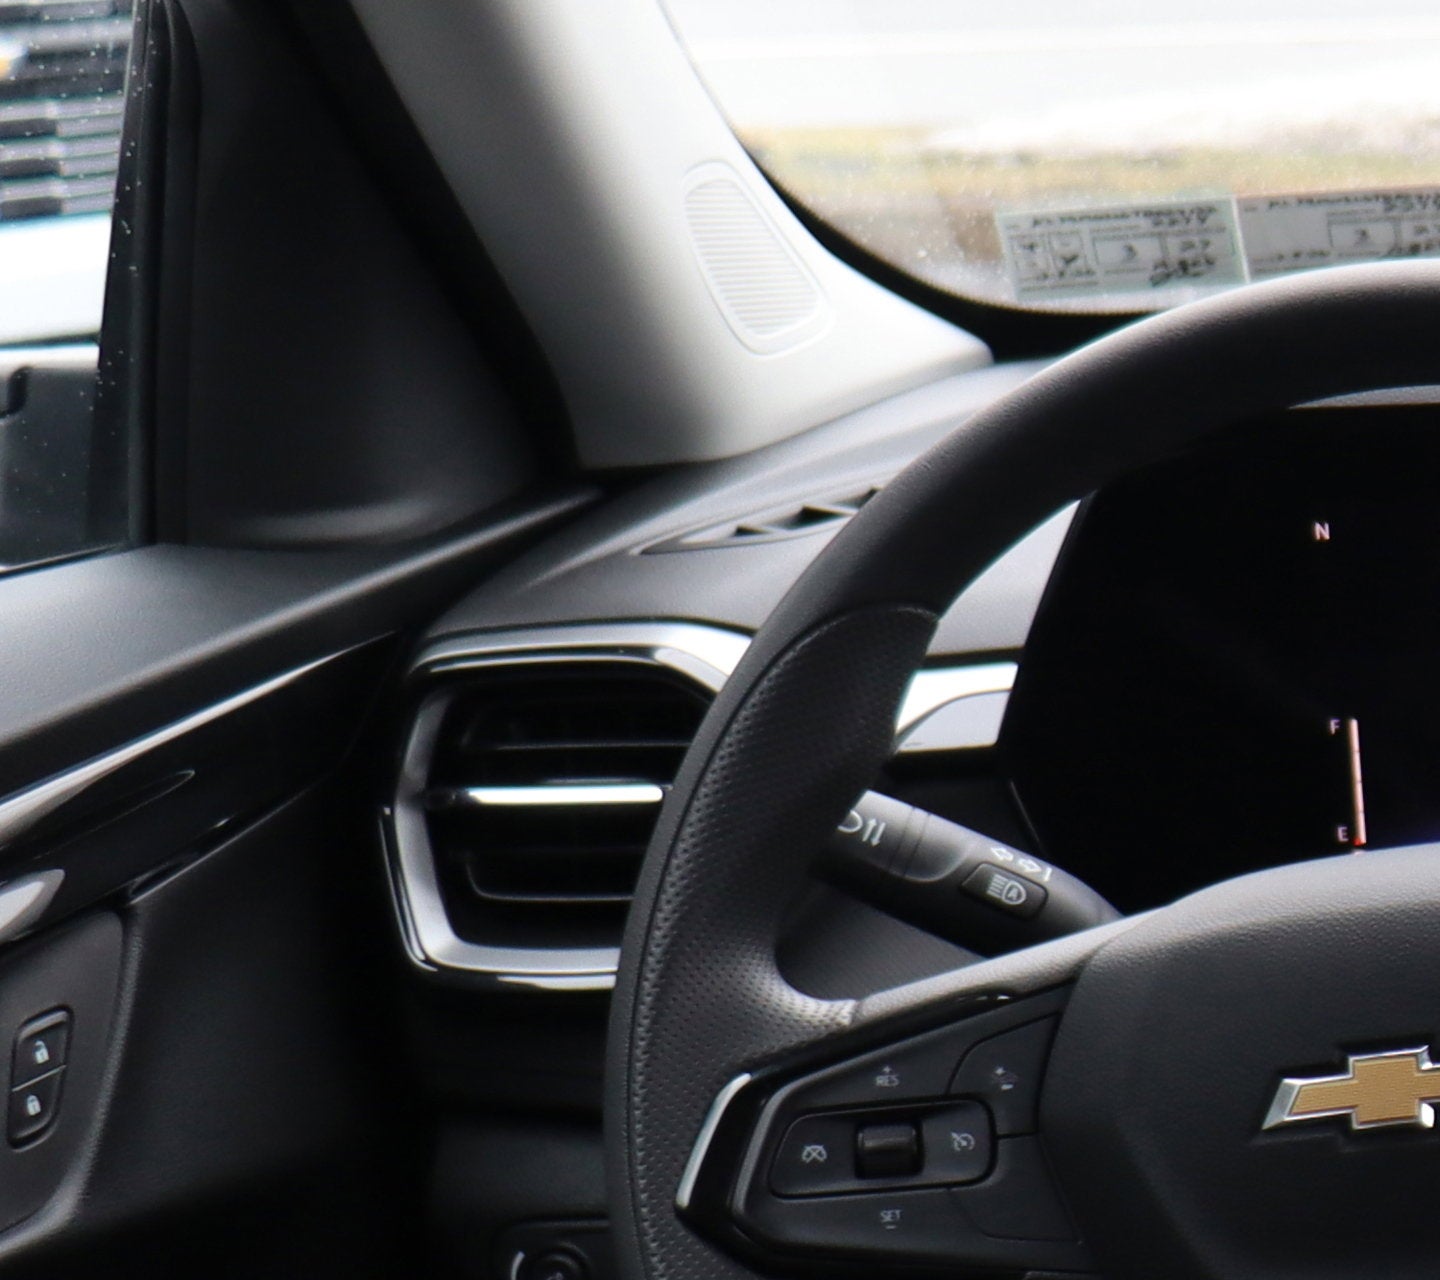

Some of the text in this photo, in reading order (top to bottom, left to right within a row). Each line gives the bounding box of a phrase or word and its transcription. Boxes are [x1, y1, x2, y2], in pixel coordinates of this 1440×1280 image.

[1314, 523, 1330, 541] N
[1330, 719, 1341, 735] F
[1337, 826, 1348, 842] E
[880, 1209, 903, 1222] SET
